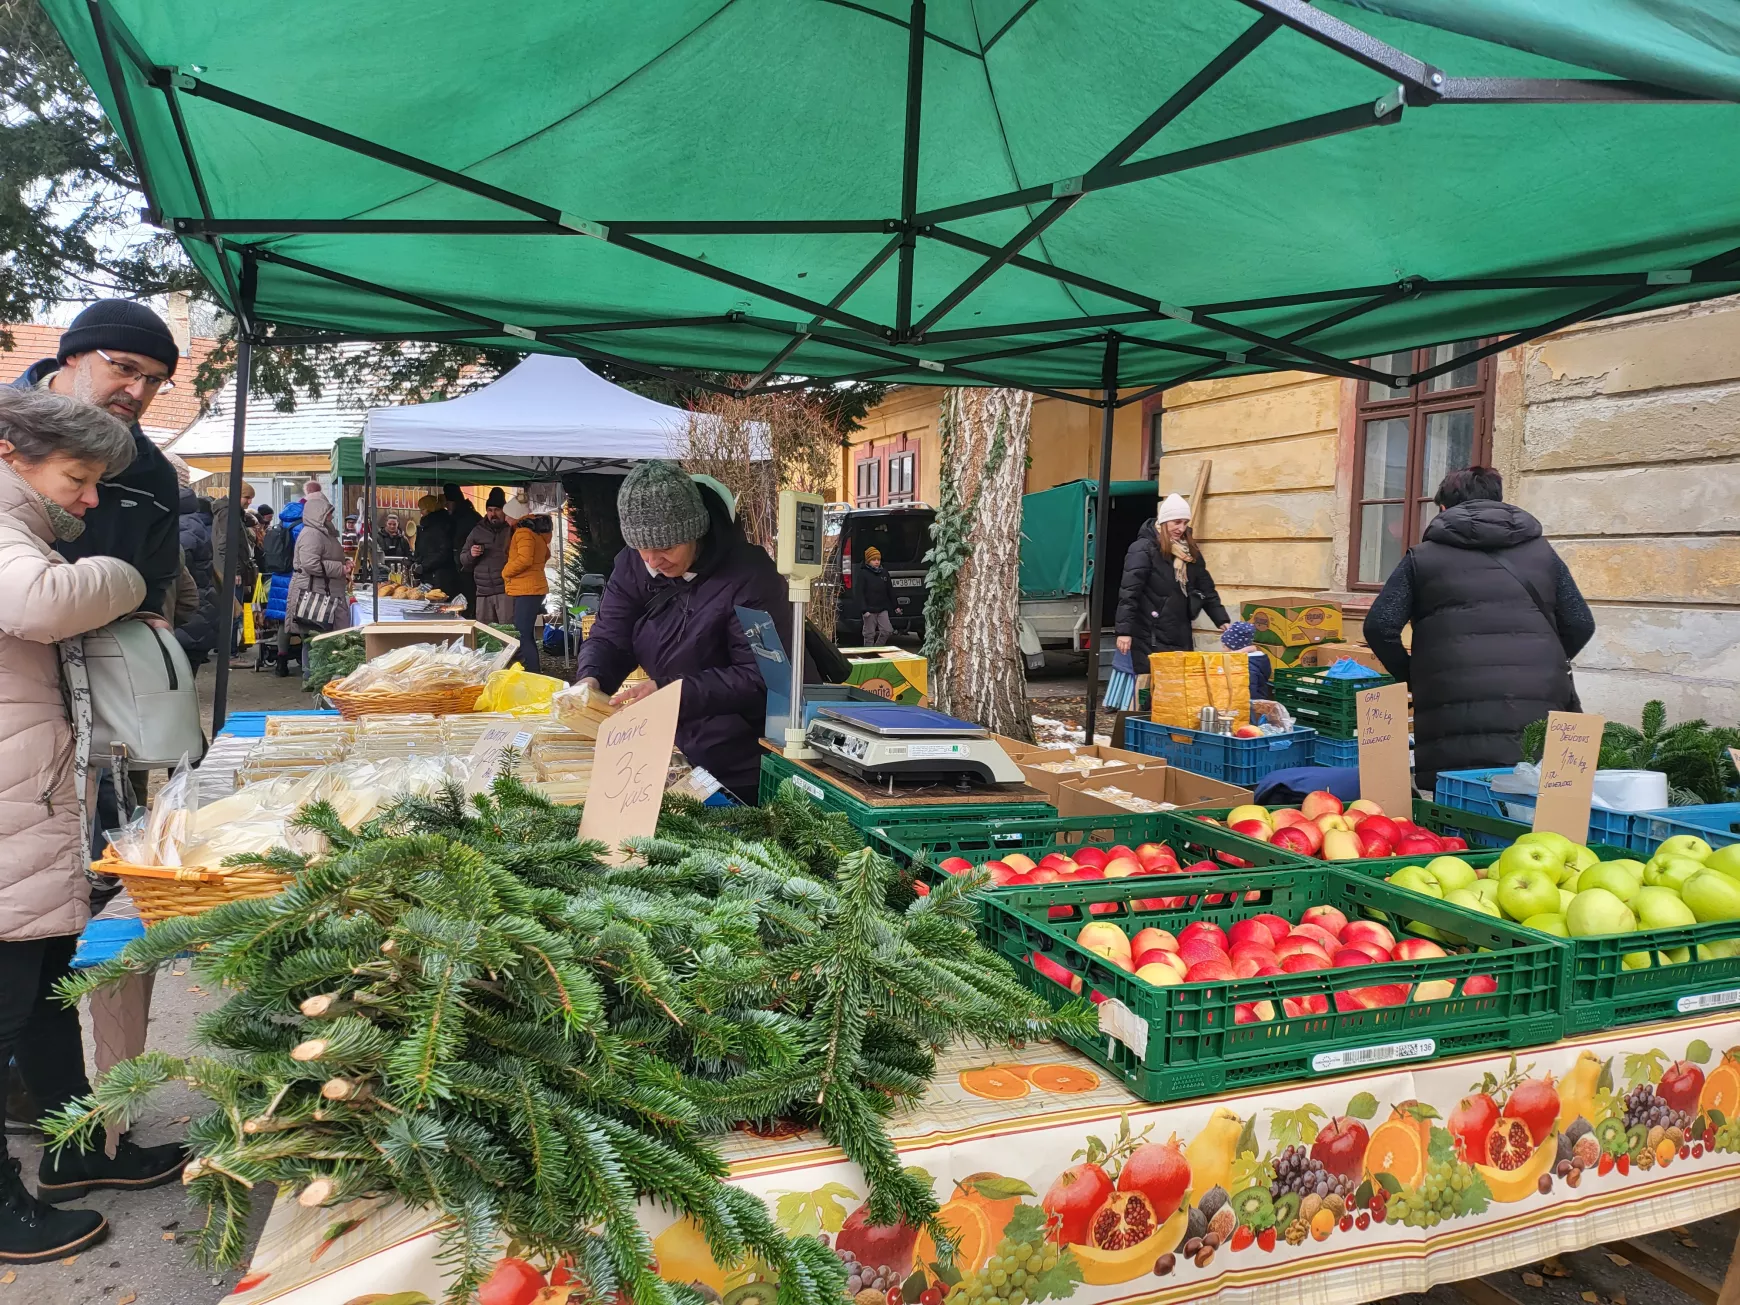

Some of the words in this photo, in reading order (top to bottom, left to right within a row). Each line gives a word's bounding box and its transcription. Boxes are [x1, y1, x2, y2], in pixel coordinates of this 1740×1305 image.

[1365, 691, 1380, 702] GALA
[1551, 718, 1577, 731] GOLDEN
[1420, 1043, 1432, 1052] 136
